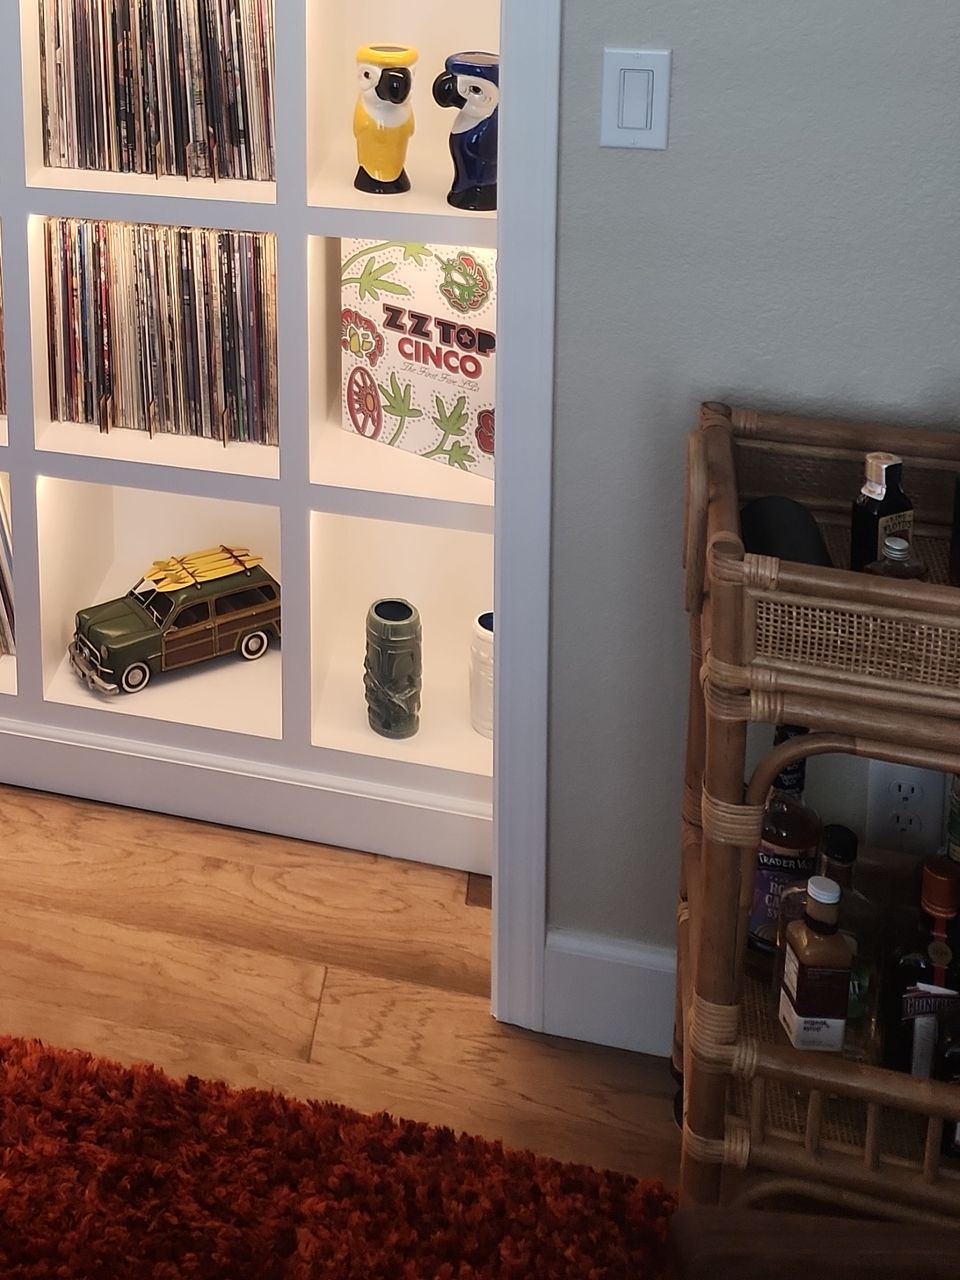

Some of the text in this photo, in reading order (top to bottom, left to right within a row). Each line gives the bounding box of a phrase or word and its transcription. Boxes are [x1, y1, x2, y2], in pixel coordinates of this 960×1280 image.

[434, 317, 496, 357] TOP
[398, 337, 482, 380] CINCO
[401, 361, 417, 373] The
[417, 368, 438, 383] First
[438, 373, 457, 386] Five
[758, 852, 796, 869] TRADER
